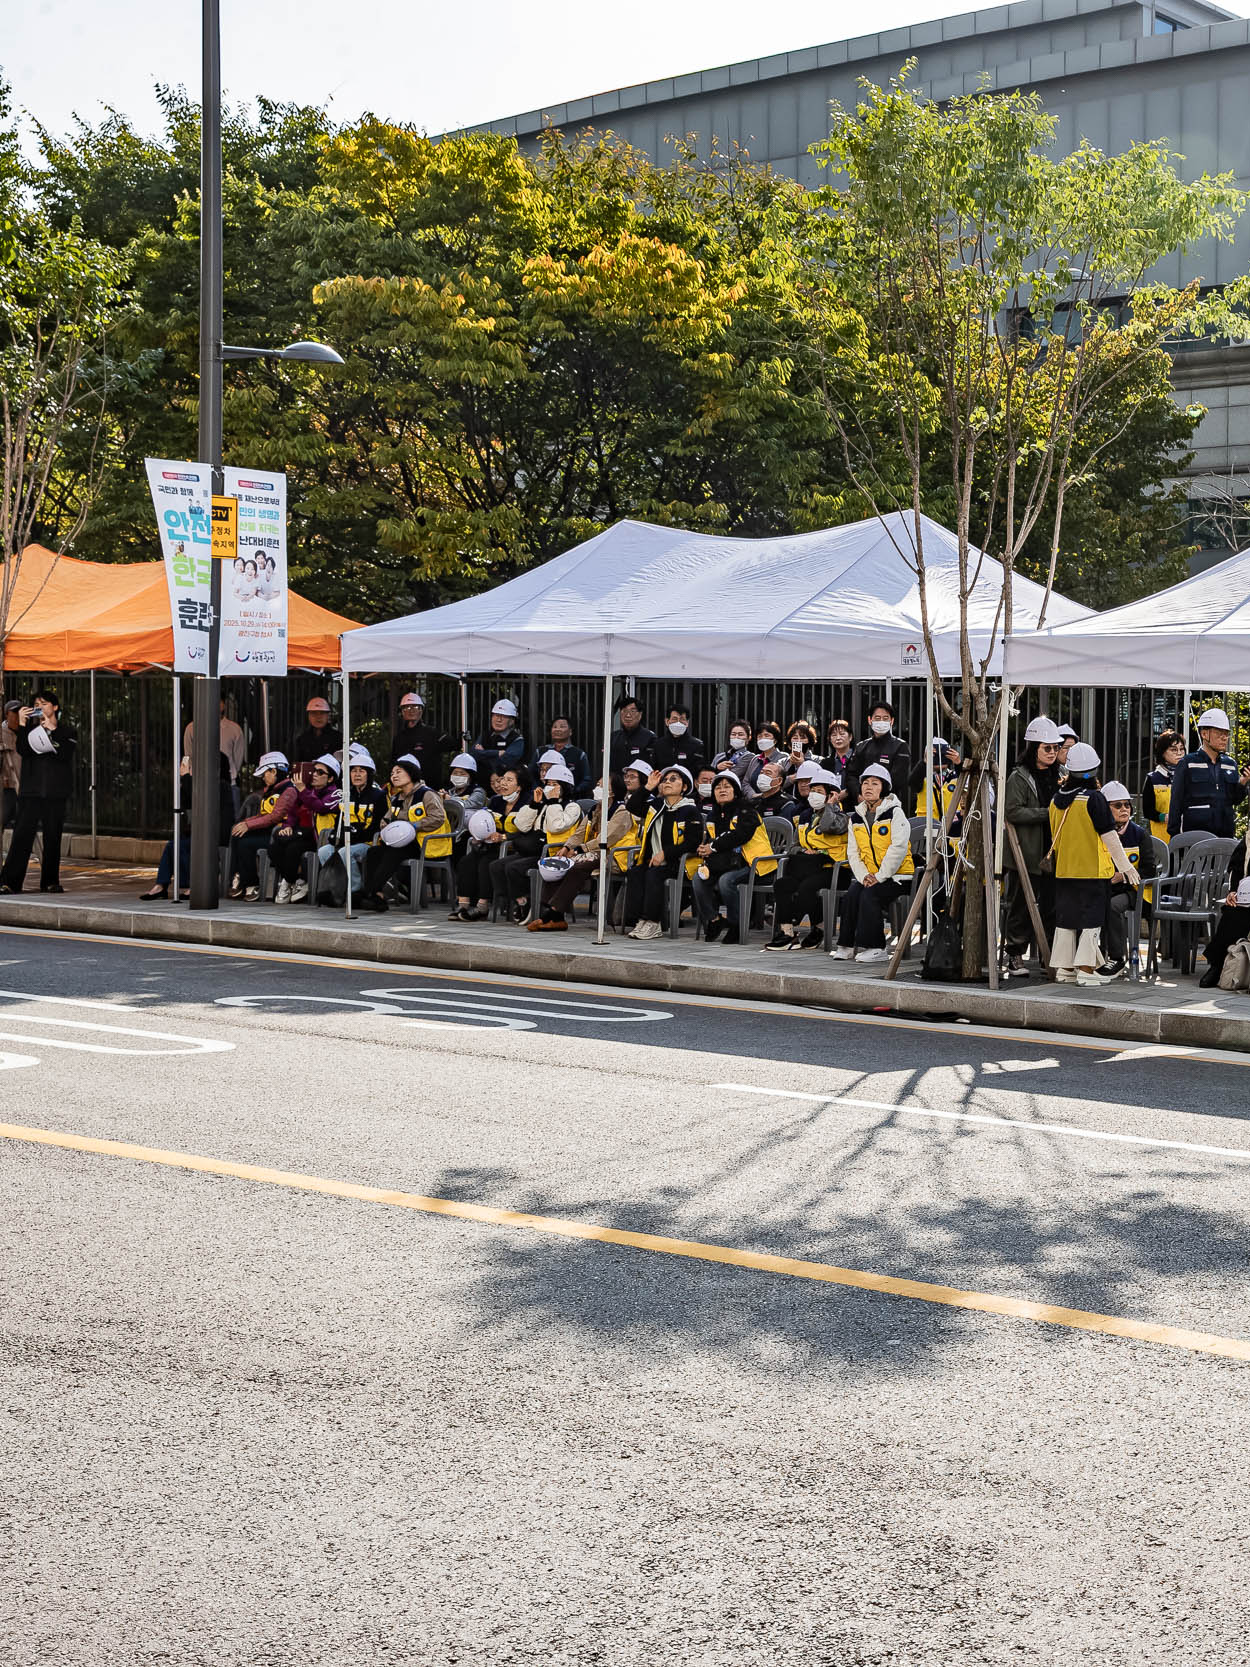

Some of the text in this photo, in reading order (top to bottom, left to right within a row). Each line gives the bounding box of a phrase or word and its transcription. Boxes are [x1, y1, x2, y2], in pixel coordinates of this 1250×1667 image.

[163, 509, 212, 545] 안전
[213, 539, 235, 551] 속지역
[239, 535, 280, 549] 난대비훈련
